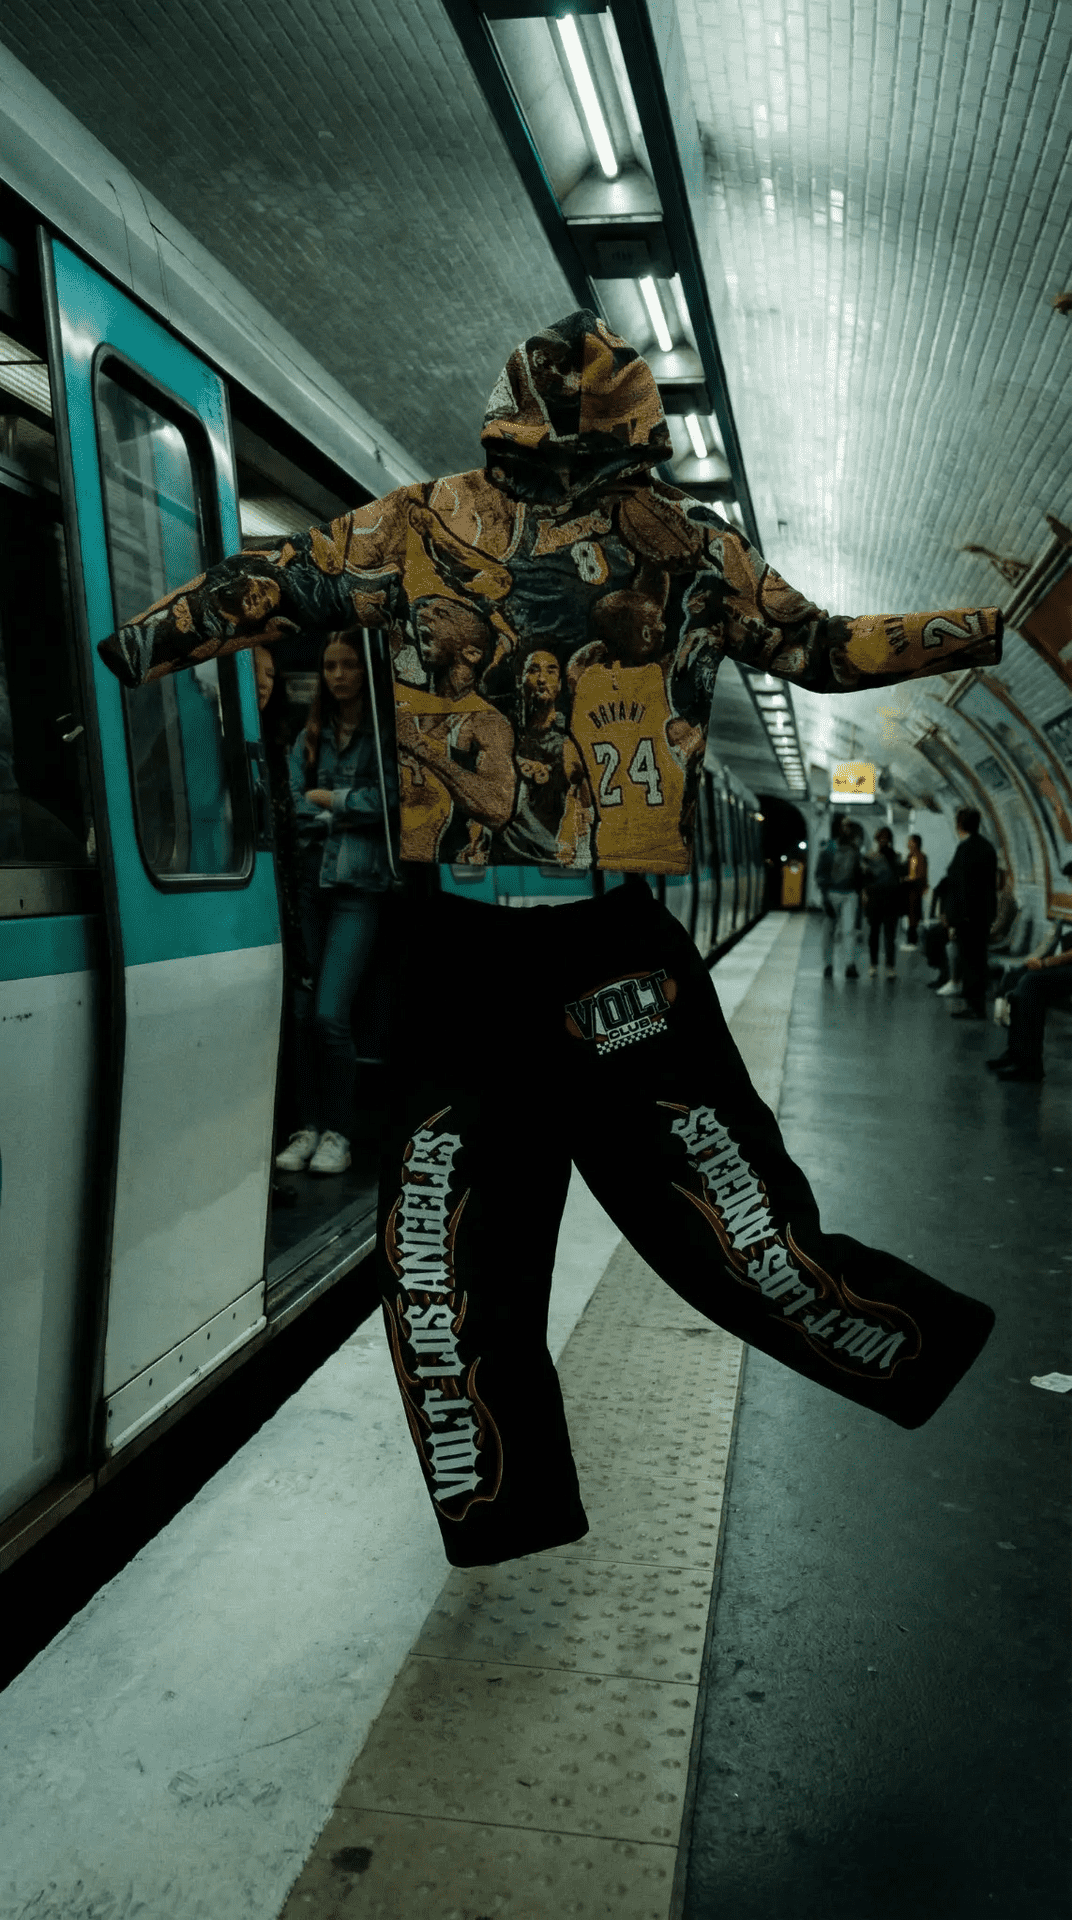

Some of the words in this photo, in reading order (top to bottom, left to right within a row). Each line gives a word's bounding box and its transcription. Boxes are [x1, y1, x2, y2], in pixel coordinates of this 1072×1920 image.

[588, 701, 646, 729] BRYANT
[591, 737, 665, 807] 24
[564, 968, 671, 1041] VOLT
[608, 1017, 651, 1040] CLUB
[396, 1128, 464, 1295] ANGELES
[670, 1105, 779, 1251] ANGELES
[747, 1243, 816, 1316] LOS
[402, 1303, 466, 1379] LOS
[802, 1308, 907, 1370] VOLT
[420, 1388, 483, 1502] VOLT
